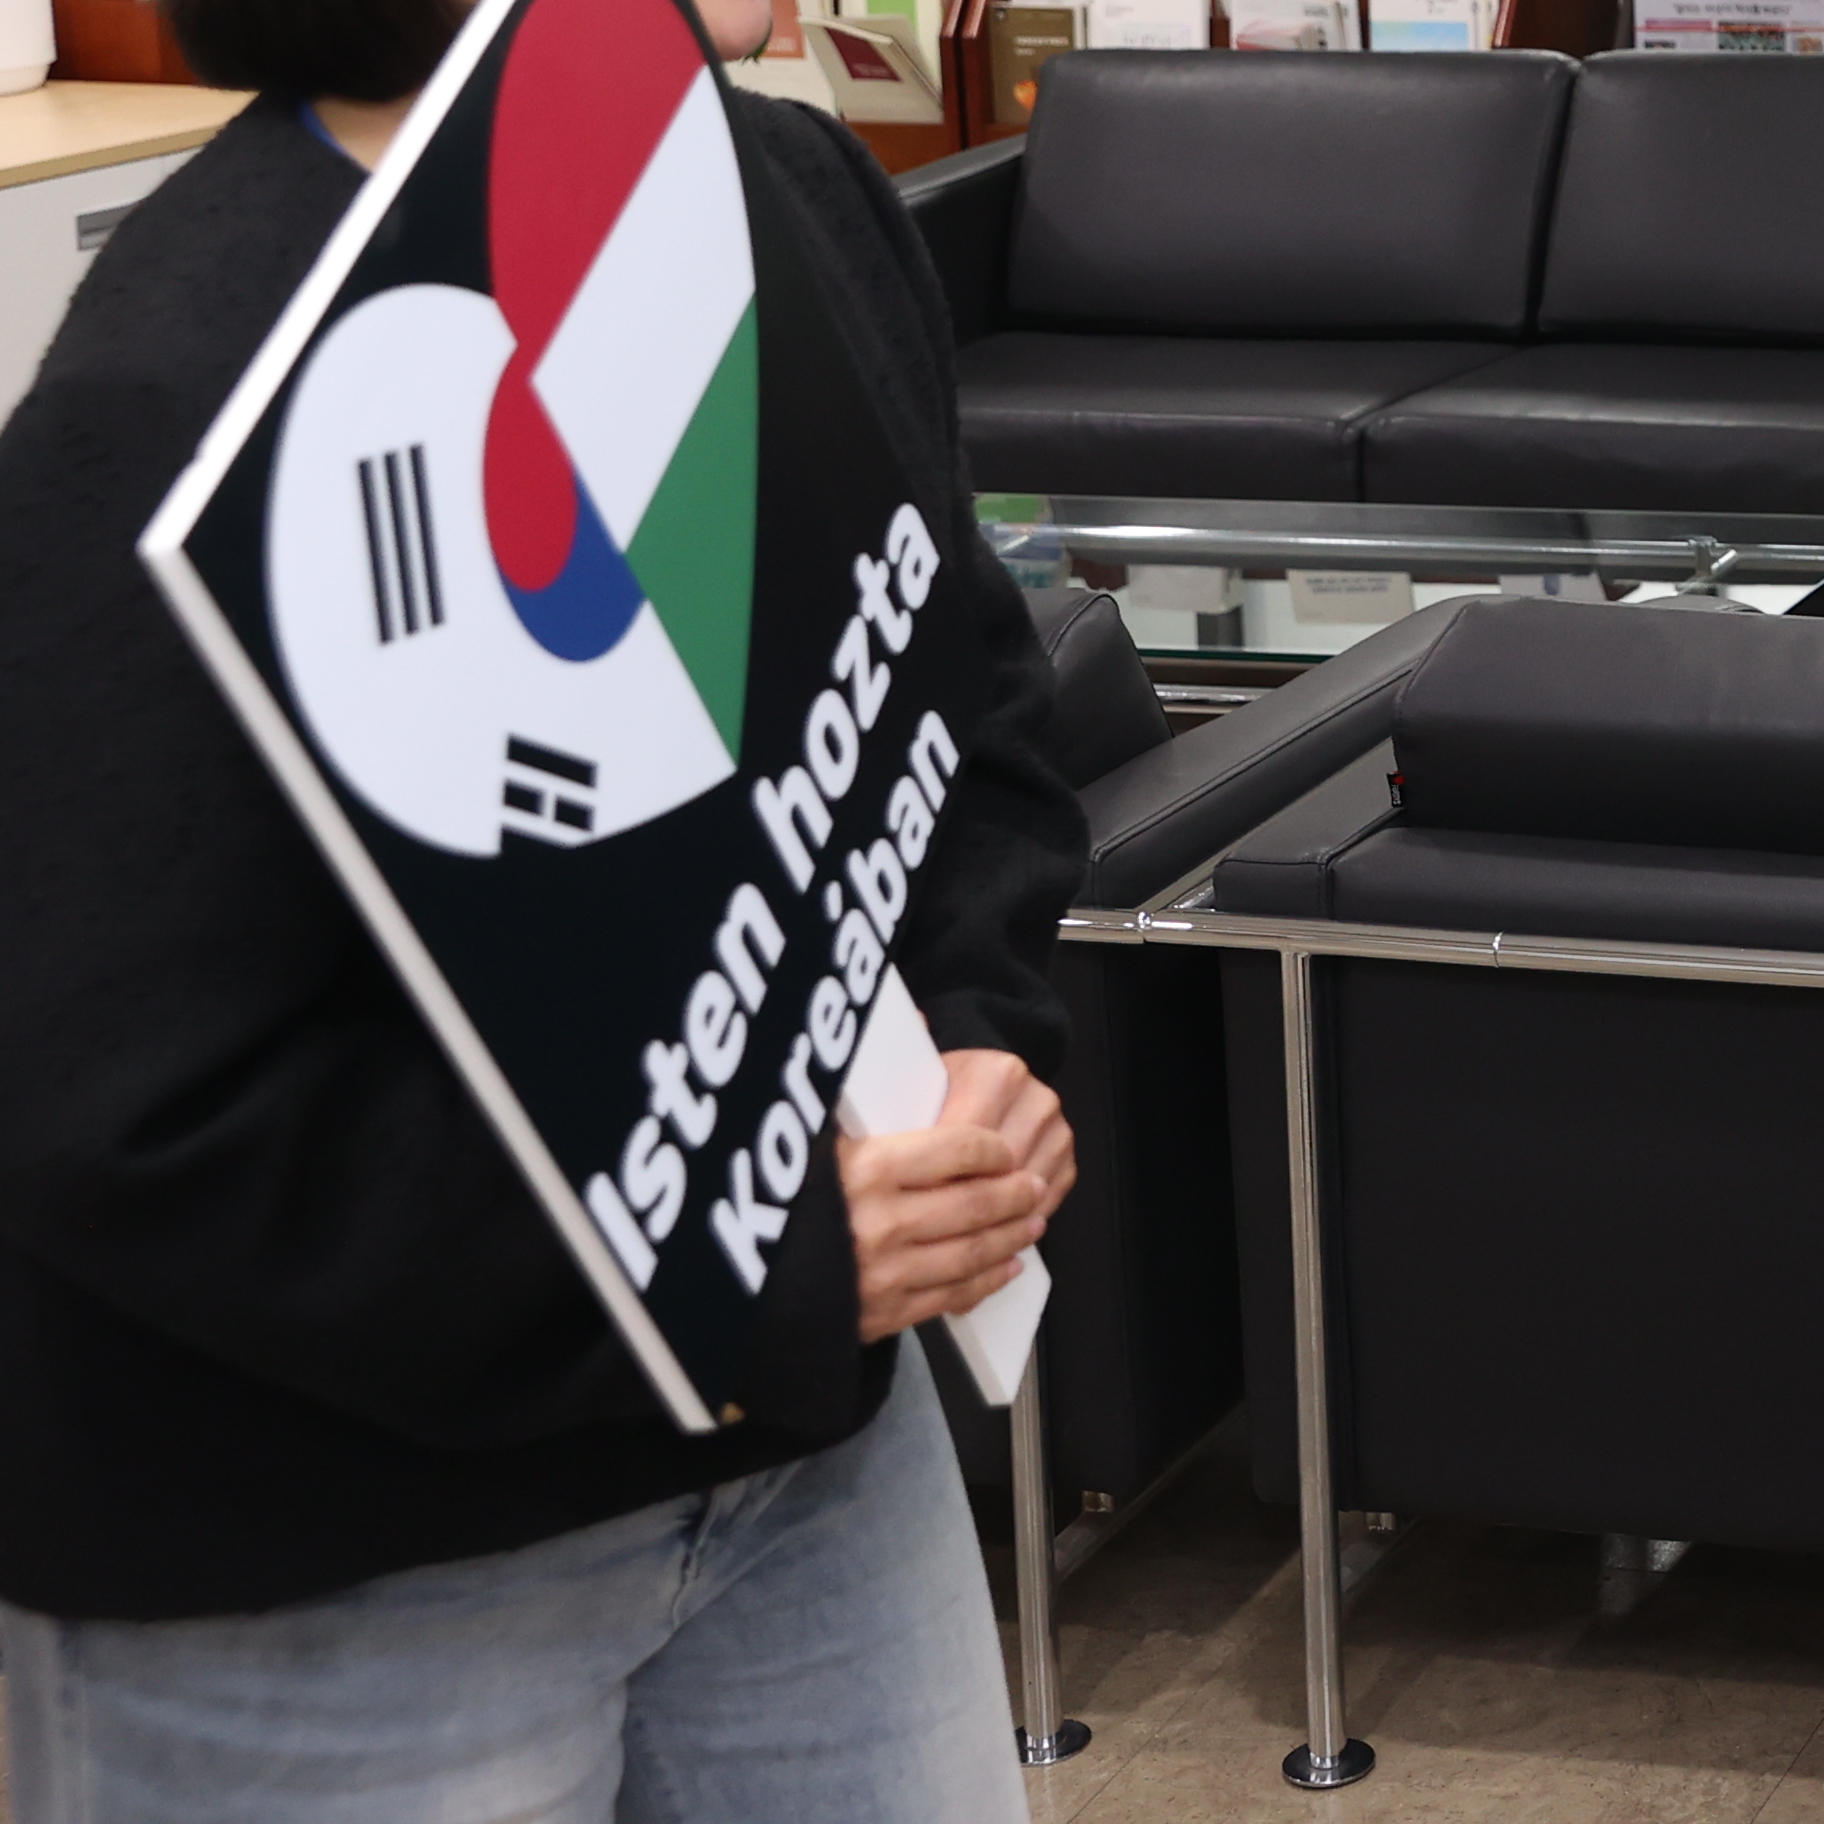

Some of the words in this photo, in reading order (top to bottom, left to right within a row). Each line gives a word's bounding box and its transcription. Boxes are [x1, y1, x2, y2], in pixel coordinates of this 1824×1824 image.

[584, 882, 787, 1291] Isten
[752, 501, 941, 894] hozta
[711, 708, 961, 1294] Koreában
